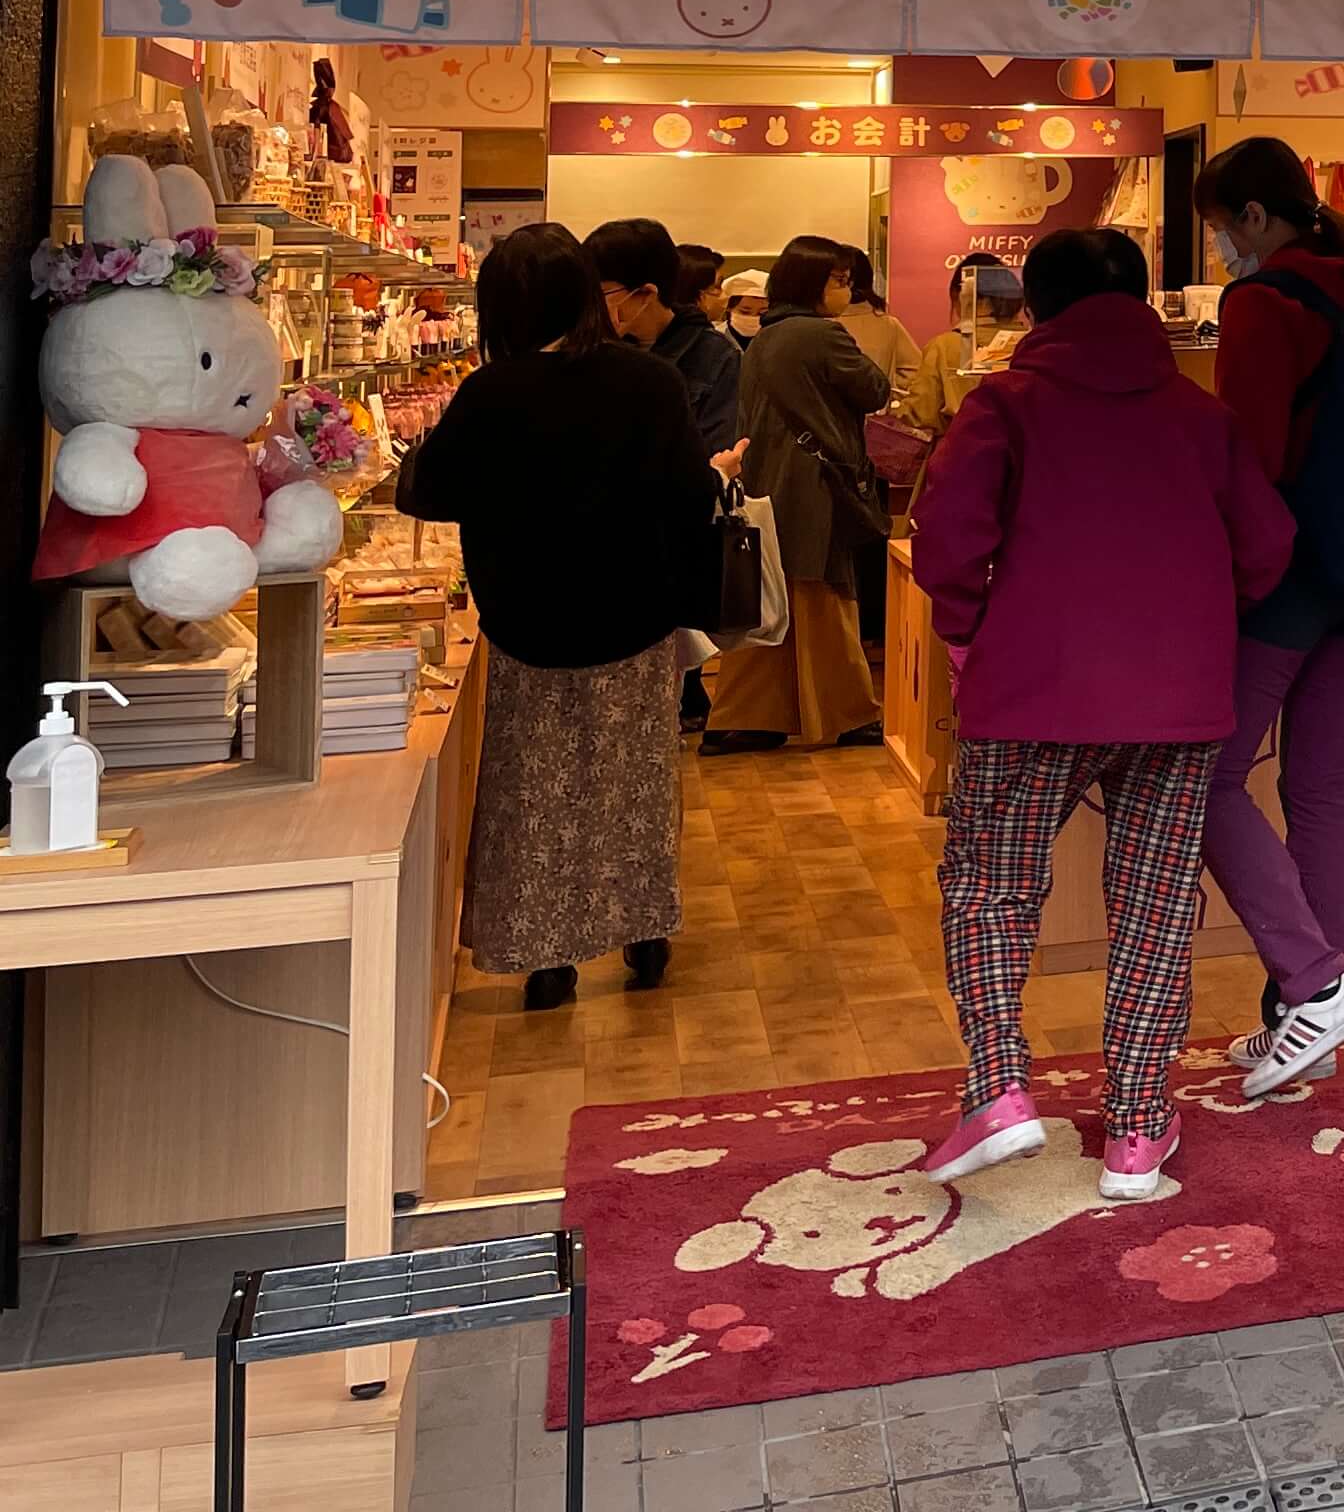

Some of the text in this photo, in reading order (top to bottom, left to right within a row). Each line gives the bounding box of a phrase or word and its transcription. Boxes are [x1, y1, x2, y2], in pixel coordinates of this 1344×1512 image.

[809, 115, 932, 148] お会計
[968, 235, 1034, 251] MIFFY
